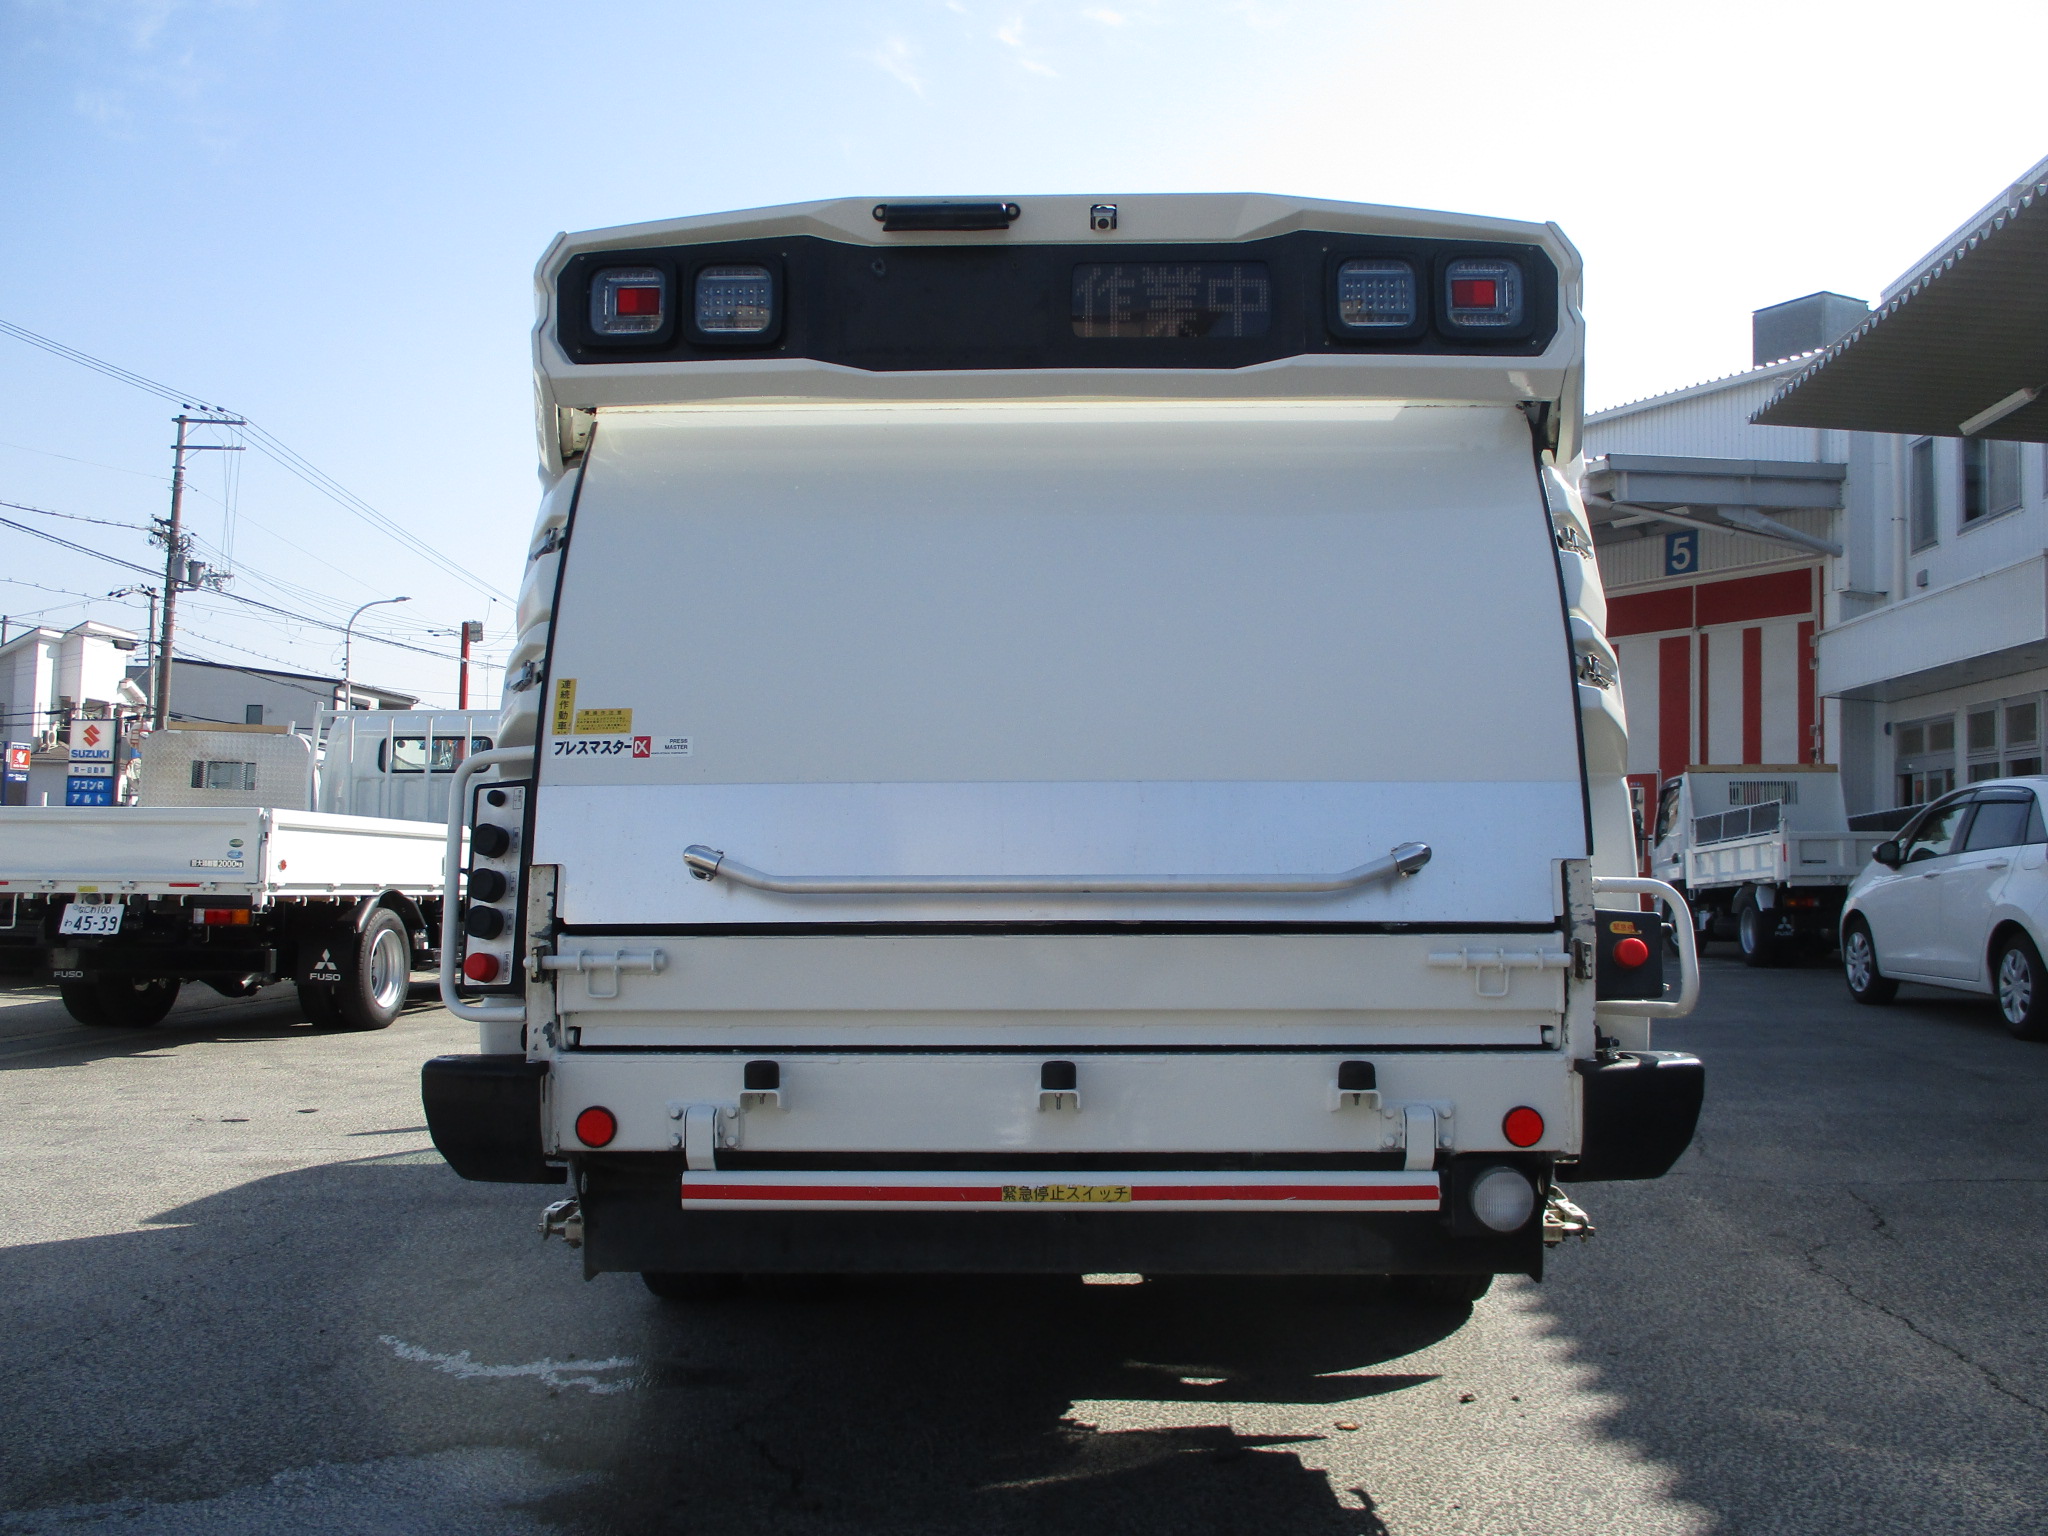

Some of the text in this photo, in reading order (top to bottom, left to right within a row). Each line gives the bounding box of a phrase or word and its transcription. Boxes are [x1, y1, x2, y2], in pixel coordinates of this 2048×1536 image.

[1075, 266, 1268, 338] 作業中
[1672, 536, 1691, 570] 5
[71, 749, 110, 759] SUZUKI
[73, 780, 104, 790] ワゴンR
[72, 793, 103, 804] アルト
[73, 915, 118, 931] 45-39
[53, 970, 84, 978] FUSO
[309, 973, 341, 981] FUSO
[1002, 1185, 1128, 1201] 緊急停止スイッチ
